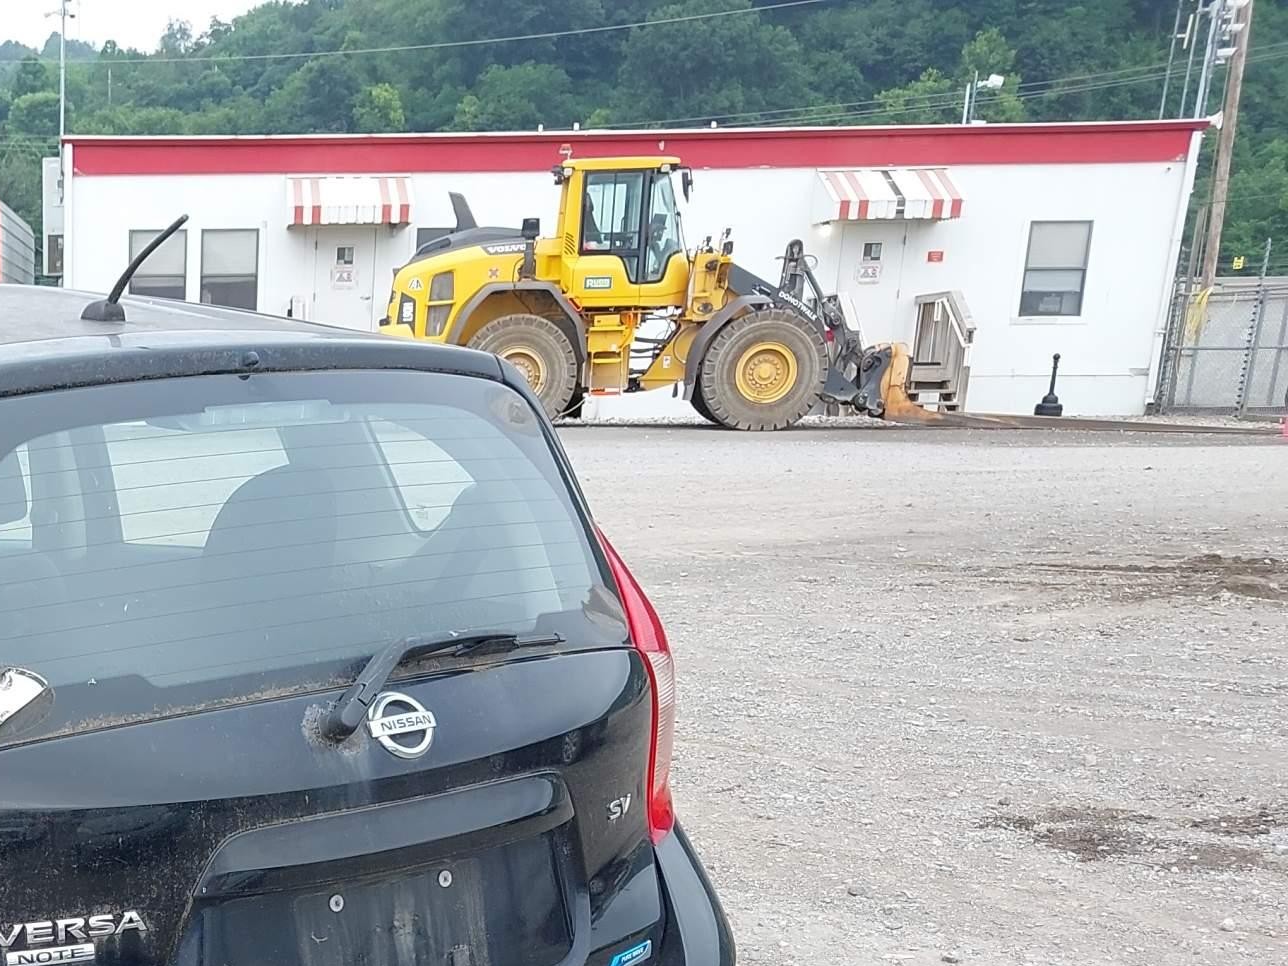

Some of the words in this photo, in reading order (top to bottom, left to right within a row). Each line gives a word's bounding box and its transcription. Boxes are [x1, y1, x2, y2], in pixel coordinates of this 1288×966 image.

[380, 714, 432, 732] NISSAN
[609, 793, 632, 820] SV
[17, 947, 86, 965] NOTE
